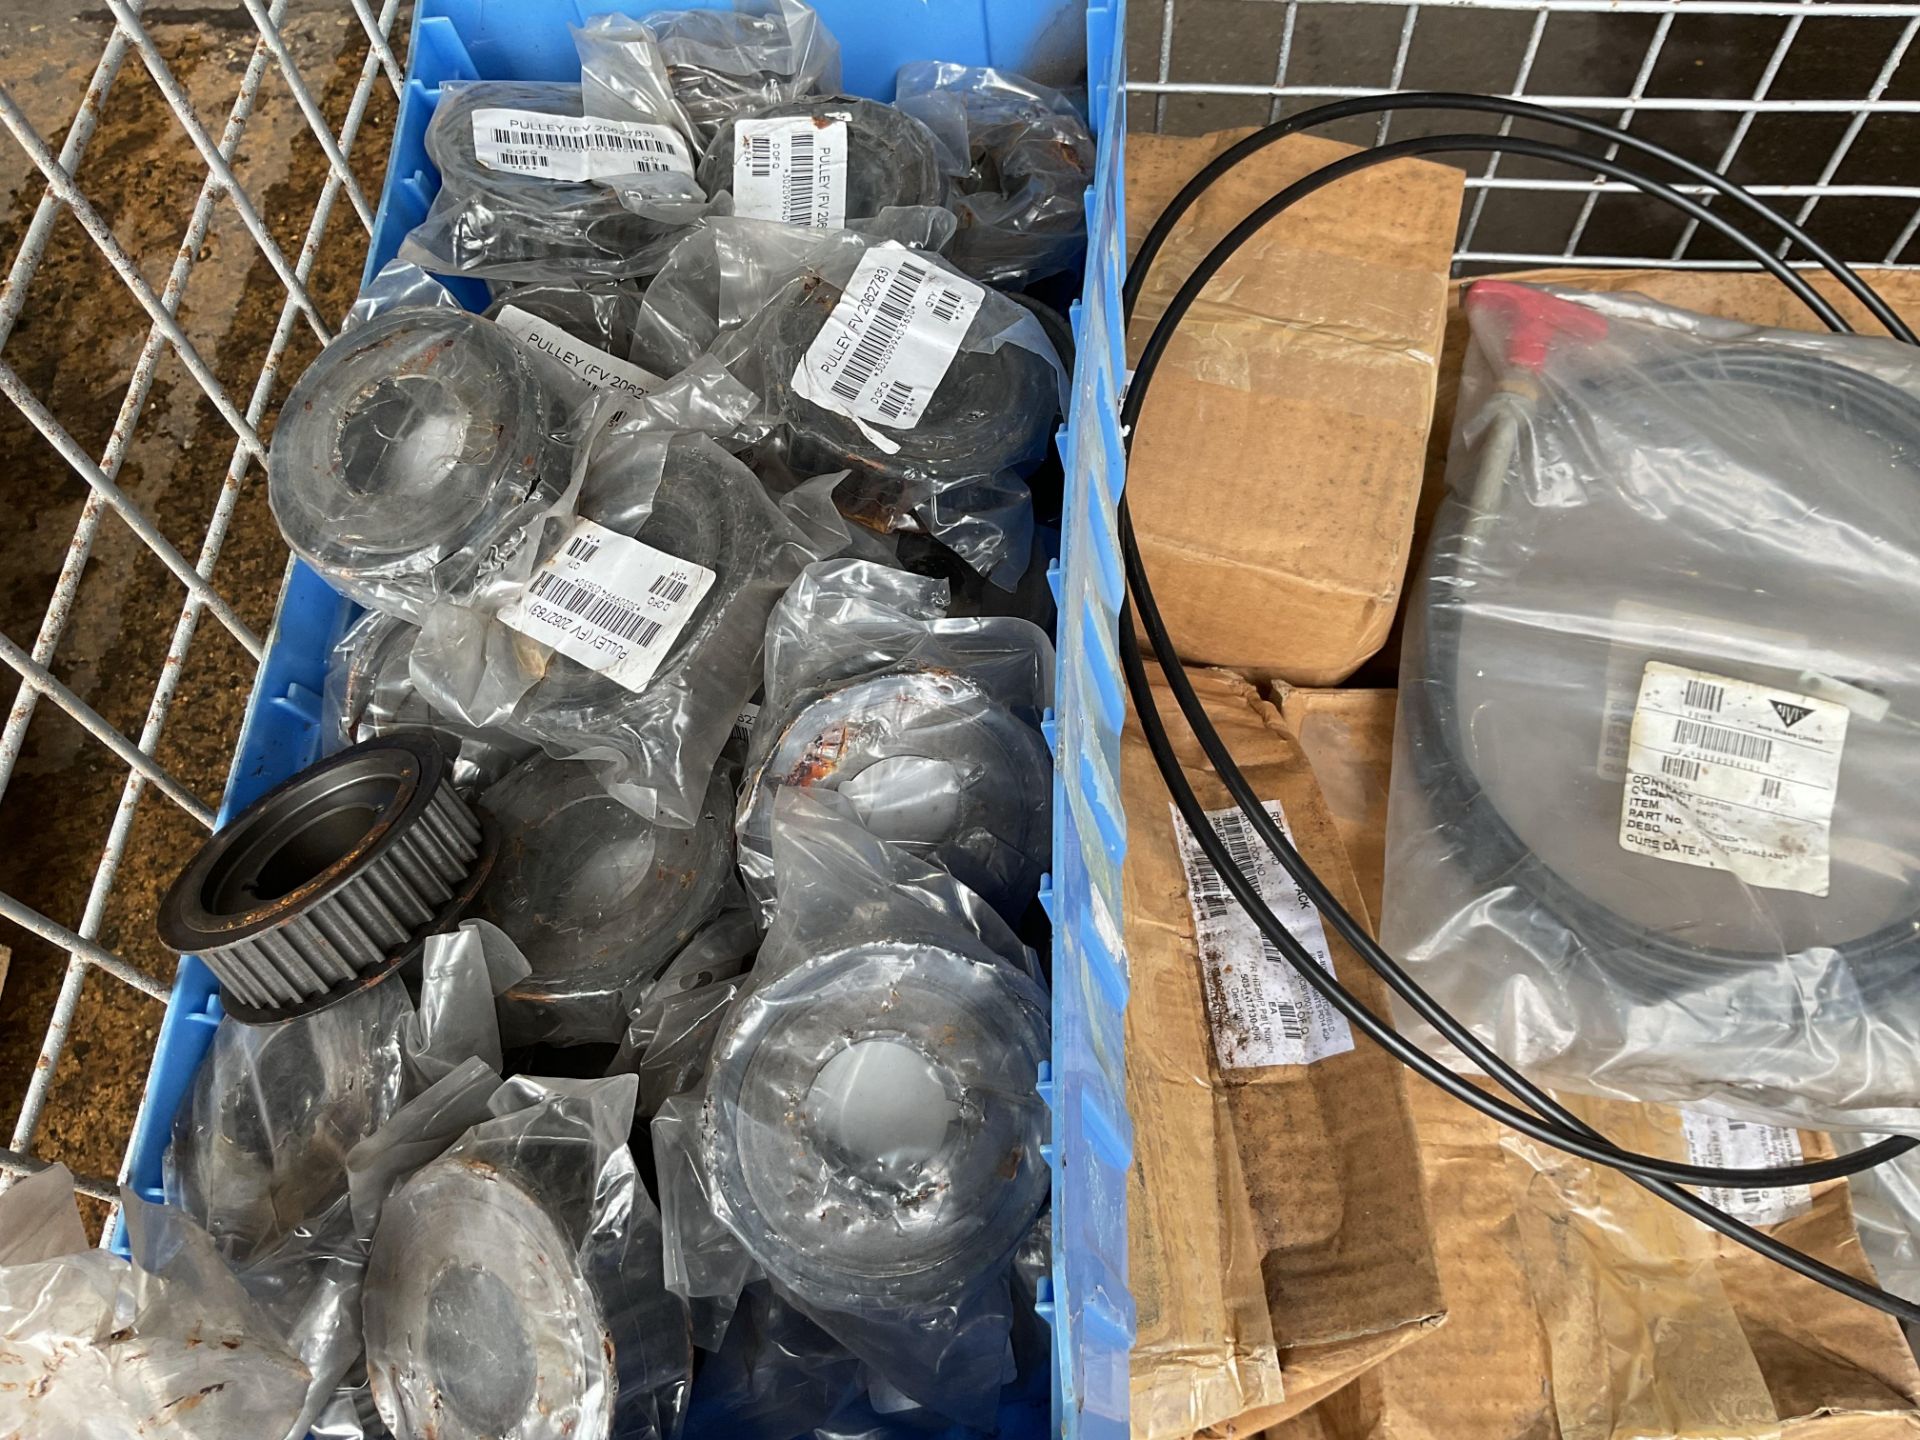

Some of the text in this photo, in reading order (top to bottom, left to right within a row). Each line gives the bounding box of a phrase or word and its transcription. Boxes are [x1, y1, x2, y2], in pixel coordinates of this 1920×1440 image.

[510, 119, 565, 131] PULLEY
[819, 147, 831, 189] PULLEY
[817, 193, 830, 212] (FV
[925, 291, 939, 308] QTY
[820, 331, 852, 375] PULLEY
[858, 266, 893, 316] 2062783)
[527, 333, 649, 399] PULLEY (FV 2062
[528, 603, 630, 660] PULLEY (FV 2062783)
[1632, 775, 1693, 801] CONTRACT
[1629, 797, 1659, 809] ITEM
[1629, 808, 1662, 821] PART
[1239, 811, 1265, 876] NATO STOCK NO
[1268, 1000, 1277, 1014] EA
[1294, 1001, 1303, 1009] D
[1296, 1010, 1306, 1024] OF
